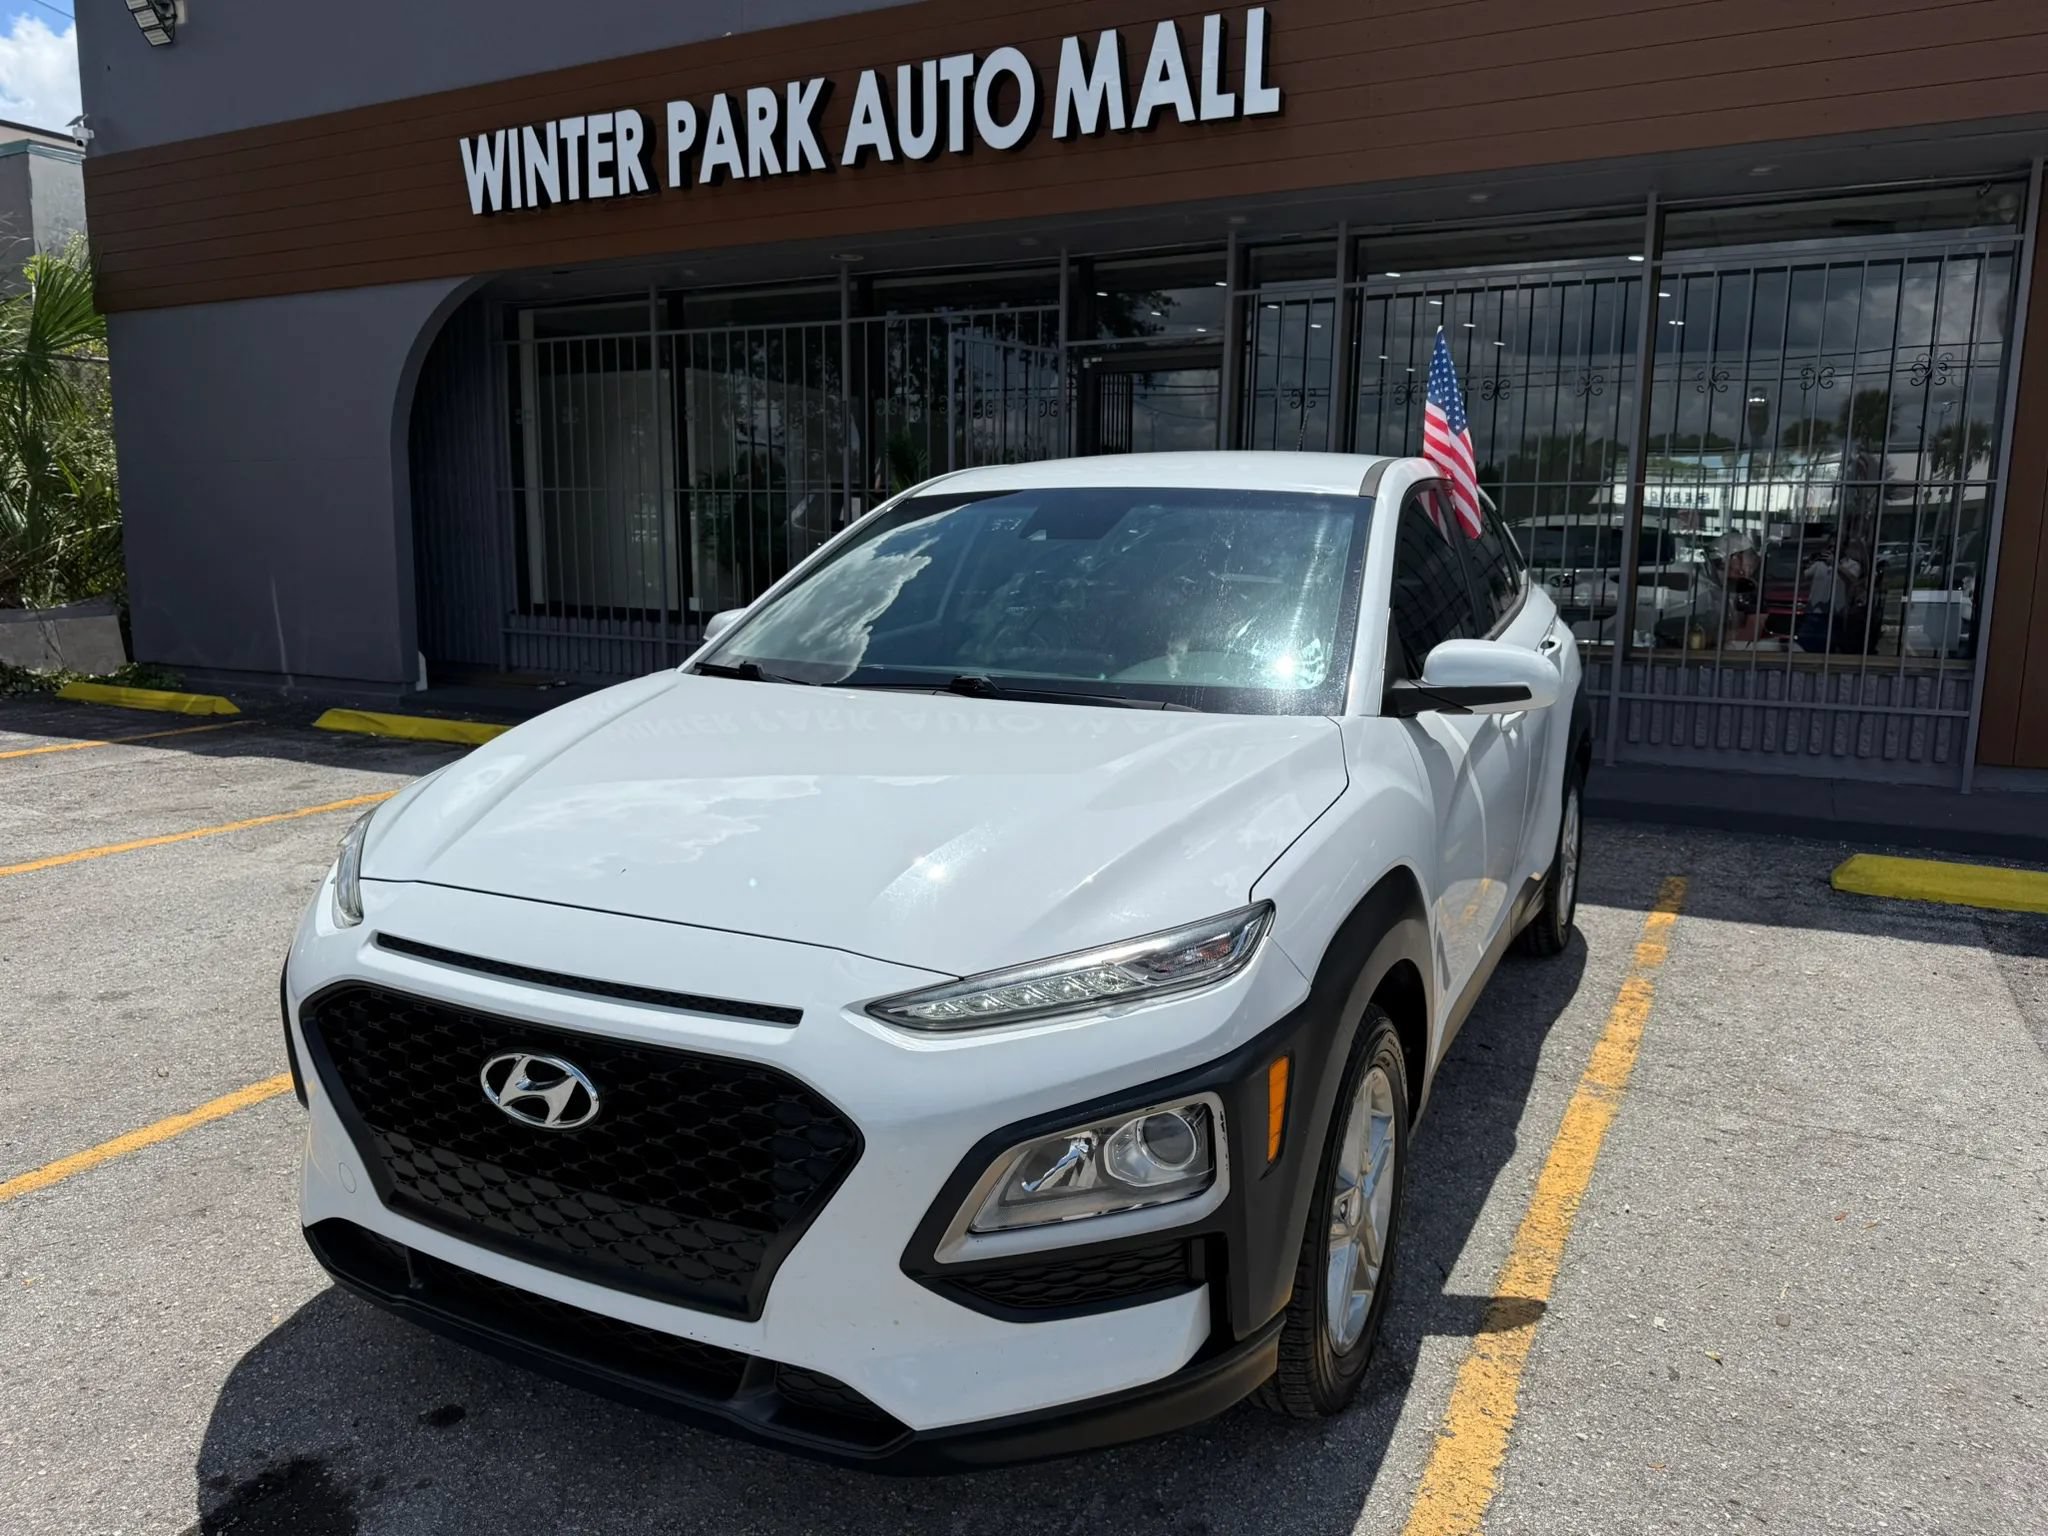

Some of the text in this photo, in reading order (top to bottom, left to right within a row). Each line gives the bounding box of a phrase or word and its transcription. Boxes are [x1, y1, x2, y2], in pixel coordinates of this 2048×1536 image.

[460, 7, 1281, 215] WINTER PARK AUTO MALL
